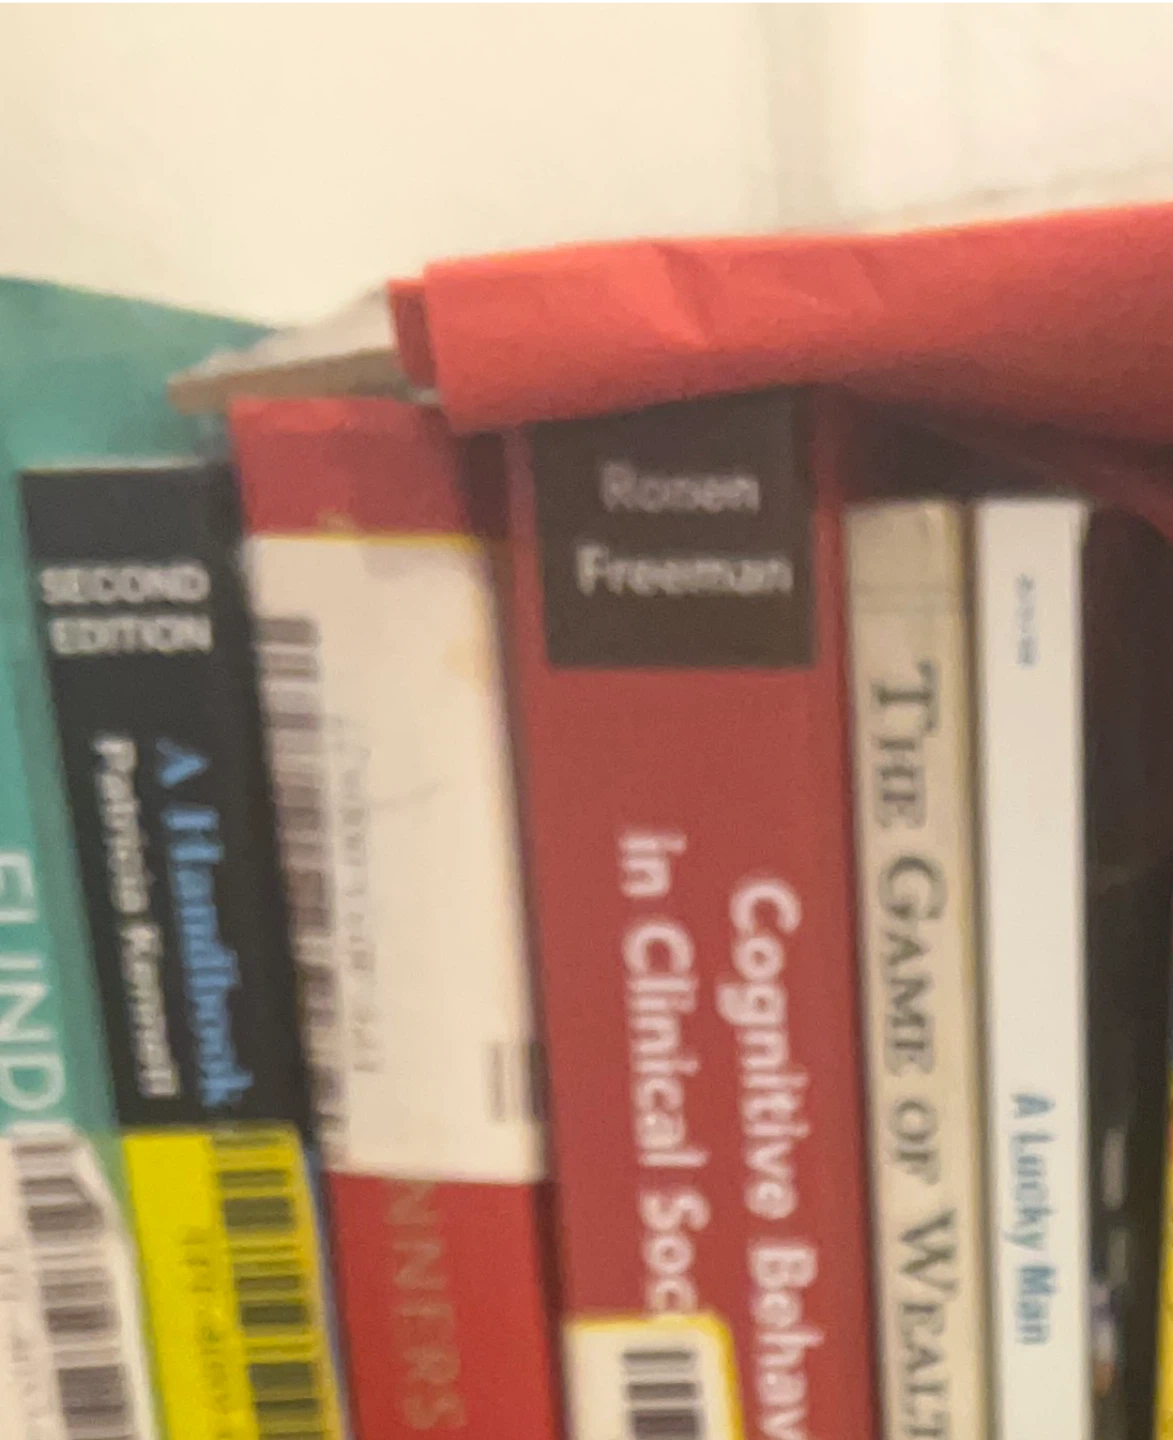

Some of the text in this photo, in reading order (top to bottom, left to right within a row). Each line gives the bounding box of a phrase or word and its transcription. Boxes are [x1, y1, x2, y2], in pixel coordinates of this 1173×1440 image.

[41, 562, 210, 605] SECOND
[52, 614, 213, 654] EDITION
[577, 545, 794, 598] Freeman
[154, 736, 254, 1108] A Handbook
[621, 919, 708, 1168] Clinical
[715, 877, 811, 1220] Cognitive
[387, 1179, 467, 1432] NNERS
[637, 1189, 710, 1313] Soc
[1003, 1093, 1059, 1347] A Lucky Man
